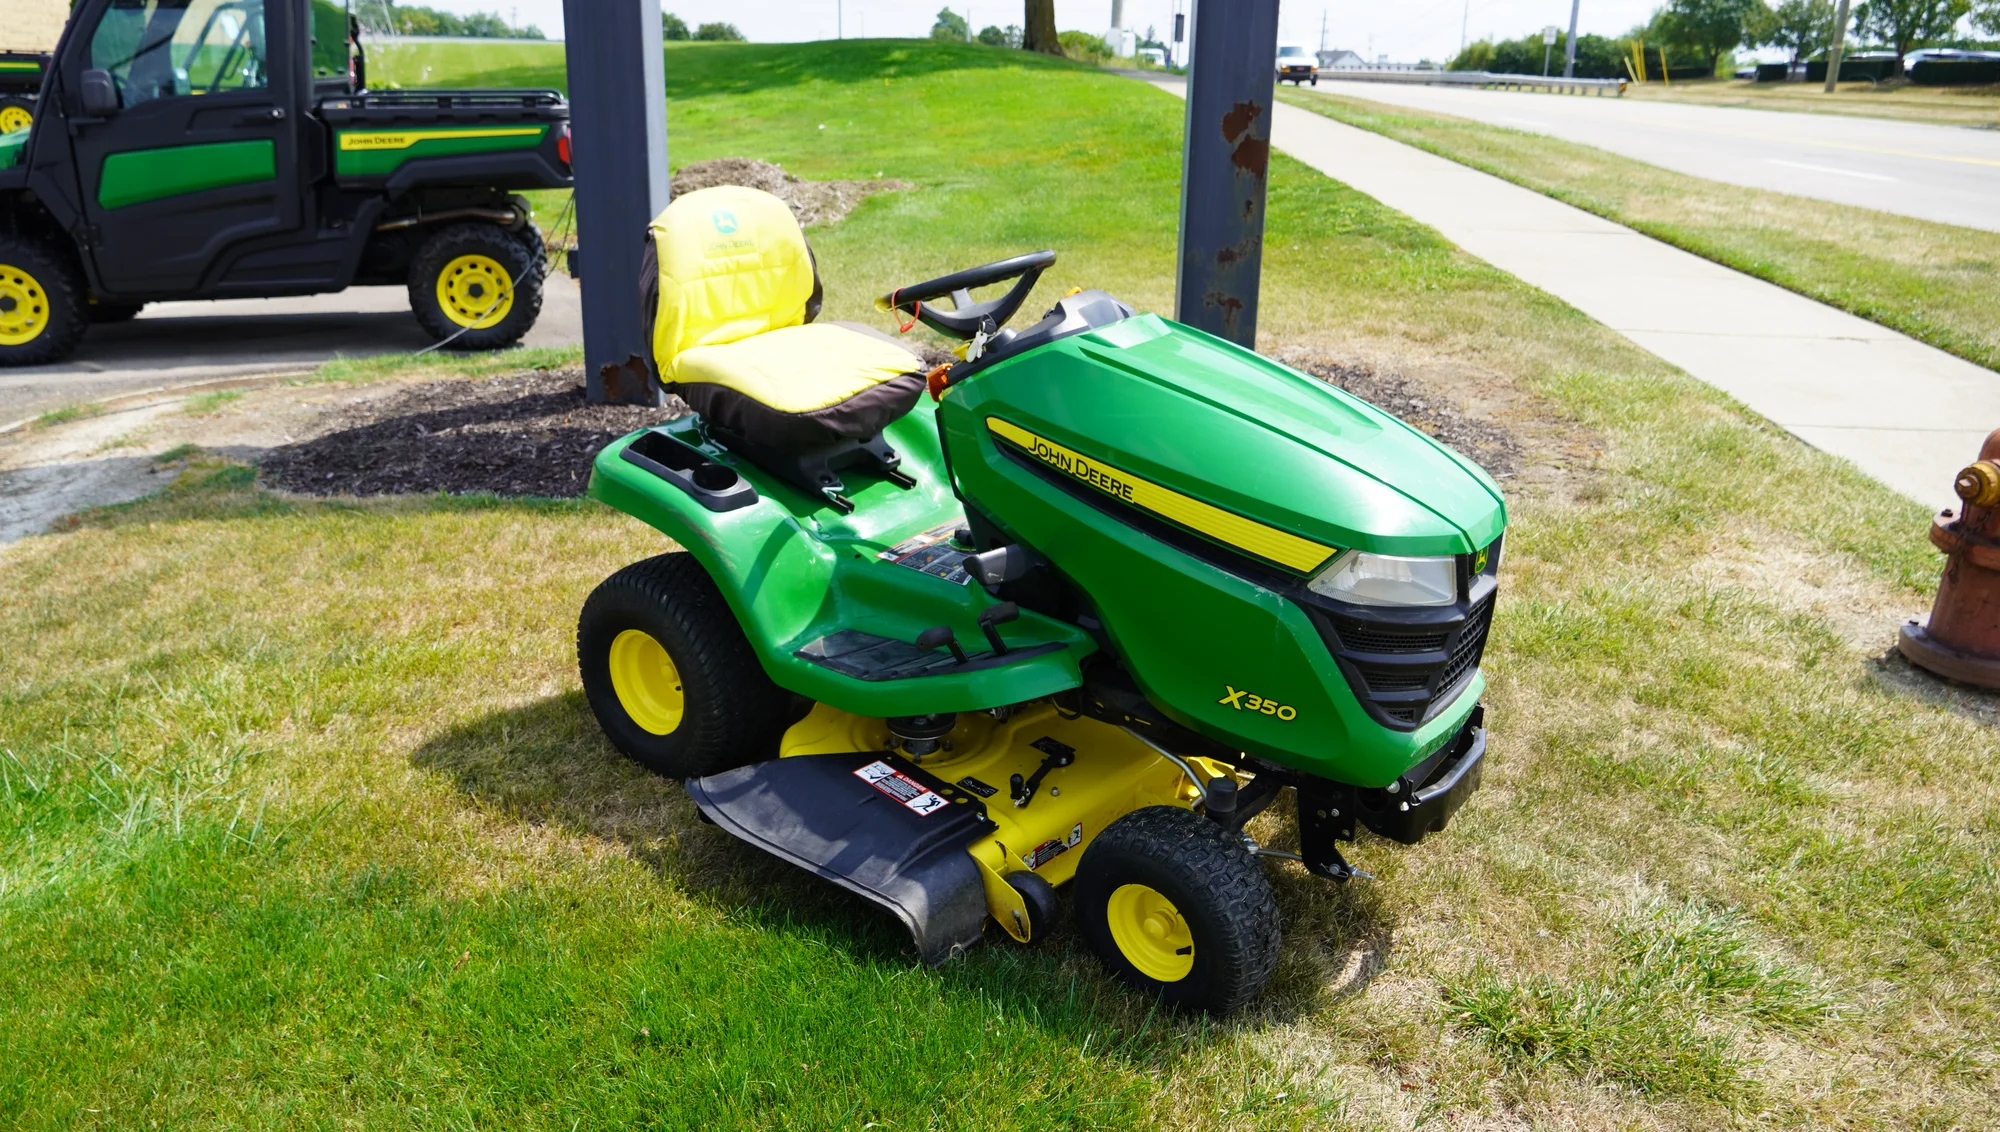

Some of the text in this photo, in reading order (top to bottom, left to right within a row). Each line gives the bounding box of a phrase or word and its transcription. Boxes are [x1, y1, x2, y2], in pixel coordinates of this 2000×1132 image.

[348, 136, 406, 146] JOHN DEERE
[1028, 437, 1134, 500] JOHN DEERE
[1217, 684, 1297, 721] X350
